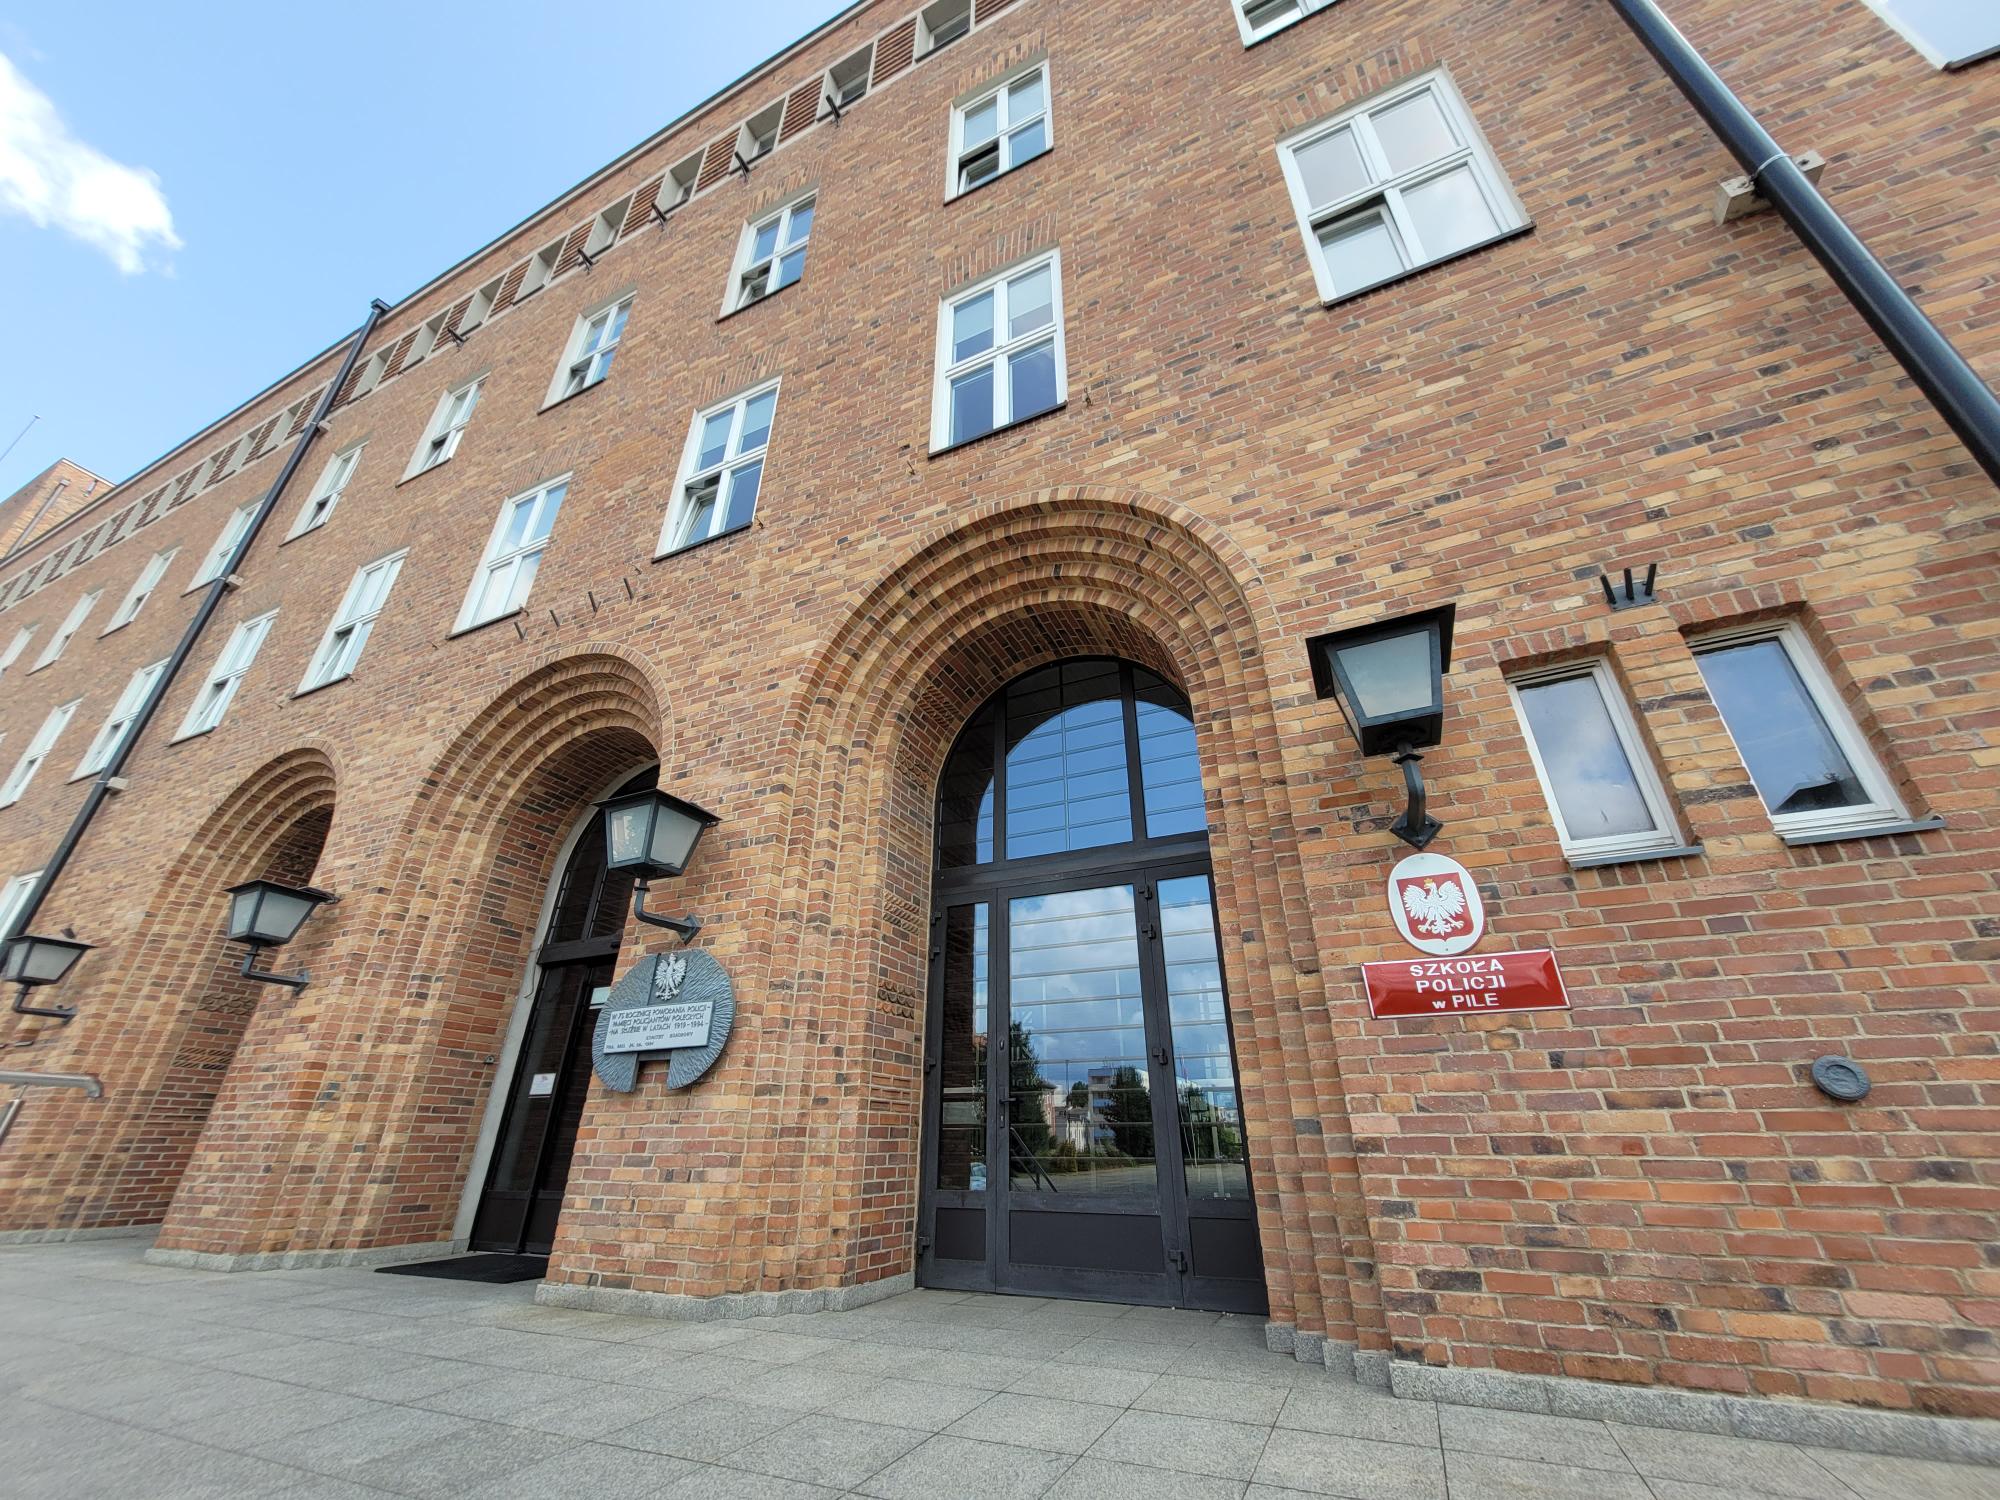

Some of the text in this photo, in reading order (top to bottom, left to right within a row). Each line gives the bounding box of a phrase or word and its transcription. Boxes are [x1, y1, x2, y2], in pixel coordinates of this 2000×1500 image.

[1409, 959, 1504, 977] SZKOŁA
[1416, 975, 1506, 994] POLICJI
[1432, 993, 1499, 1010] w PILE
